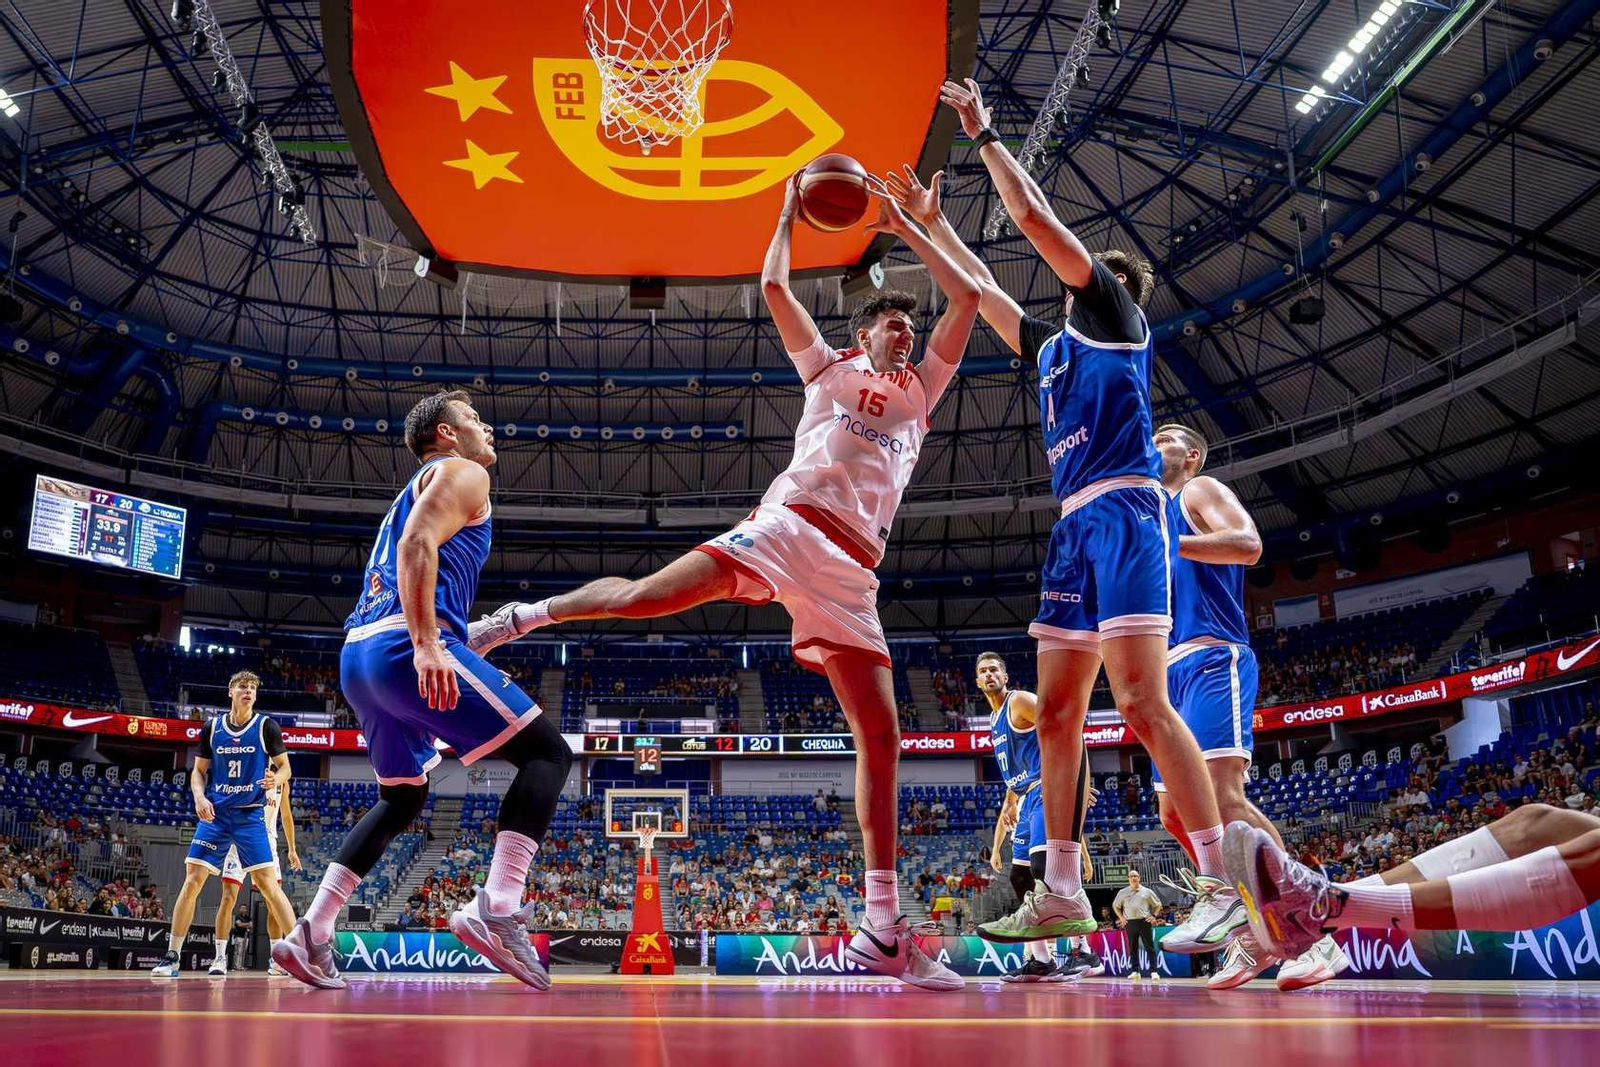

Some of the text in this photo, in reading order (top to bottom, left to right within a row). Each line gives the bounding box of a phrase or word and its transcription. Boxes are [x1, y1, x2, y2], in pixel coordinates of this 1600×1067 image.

[552, 73, 586, 120] FEB
[858, 388, 888, 418] 15
[94, 493, 109, 504] 17
[119, 499, 133, 510] 20
[1471, 661, 1526, 687] tenerife!
[1385, 686, 1440, 706] CaixaBank
[1283, 705, 1344, 723] endesa
[281, 732, 328, 745] CaixaBank
[594, 737, 609, 750] 17
[715, 738, 733, 750] 12
[750, 737, 771, 750] 20
[802, 739, 846, 750] CHEQUIA
[901, 736, 954, 749] endesa
[216, 745, 256, 755] ČESKO
[638, 748, 658, 762] 12
[228, 760, 242, 778] 21
[62, 922, 87, 937] endesa
[580, 936, 621, 947] endesa
[629, 955, 667, 964] CaixaBank
[753, 936, 868, 974] Andal
